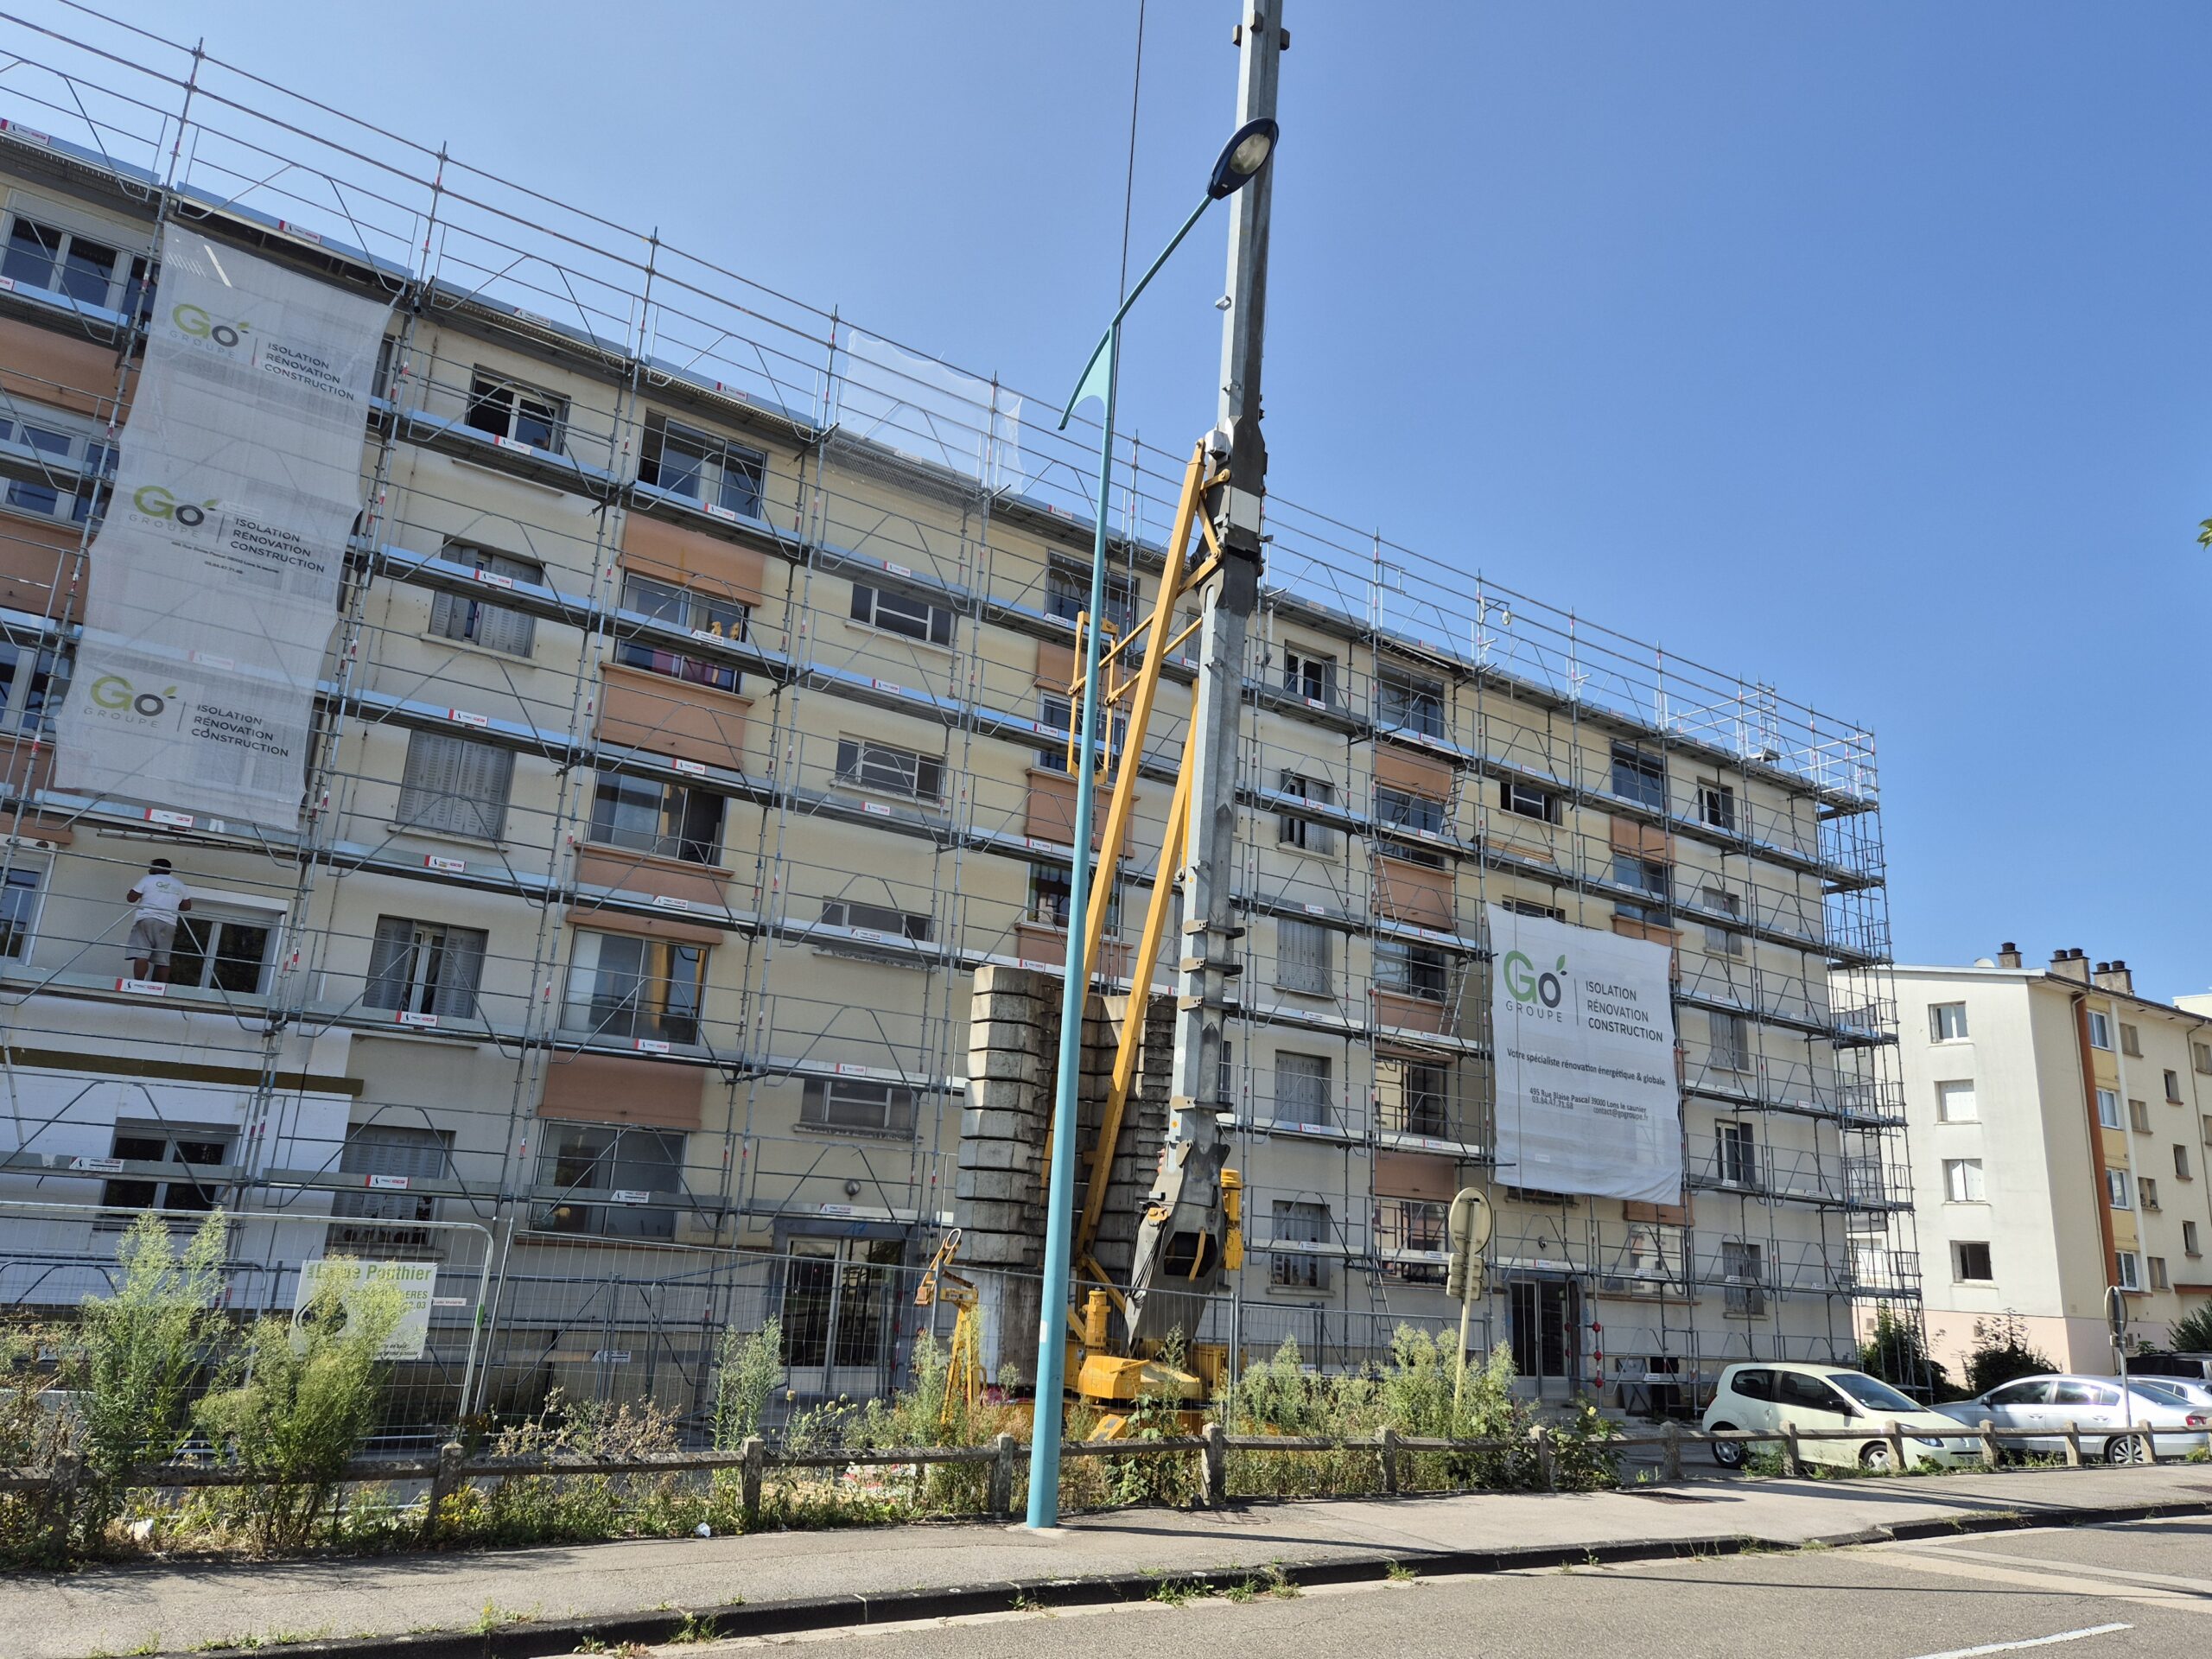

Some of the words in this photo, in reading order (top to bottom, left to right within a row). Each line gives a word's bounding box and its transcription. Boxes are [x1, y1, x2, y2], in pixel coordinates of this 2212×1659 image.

[268, 342, 329, 370] ISOLATION
[266, 353, 340, 385] RÉNOVATION
[264, 364, 354, 401] CONSTRUCTION
[233, 529, 311, 557] RÉNOVATION
[235, 518, 300, 543] ISOLATION
[231, 541, 325, 574] CONSTRUCTION
[84, 707, 159, 728] GROUPE
[198, 704, 262, 725] ISOLATION
[194, 715, 273, 741] RÉNOVATION
[192, 728, 289, 757] CONSTRUCTION
[1586, 981, 1637, 1001] ISOLATION
[1506, 1001, 1562, 1022] GROUPE
[1587, 999, 1649, 1022] RÉNOVATION
[1588, 1017, 1662, 1042] CONSTRUCTION
[1507, 1048, 1525, 1060] Votre
[1527, 1053, 1560, 1067] spécialiste
[1561, 1059, 1597, 1072] rénovation
[1599, 1065, 1635, 1080] énergétique
[1637, 1072, 1642, 1081] &
[1643, 1074, 1666, 1085] globale
[1529, 1087, 1540, 1096] 495
[1554, 1091, 1569, 1101] Blaise
[1571, 1095, 1590, 1103] Pascal
[1591, 1096, 1605, 1107] 39000
[1607, 1100, 1619, 1109] Lons
